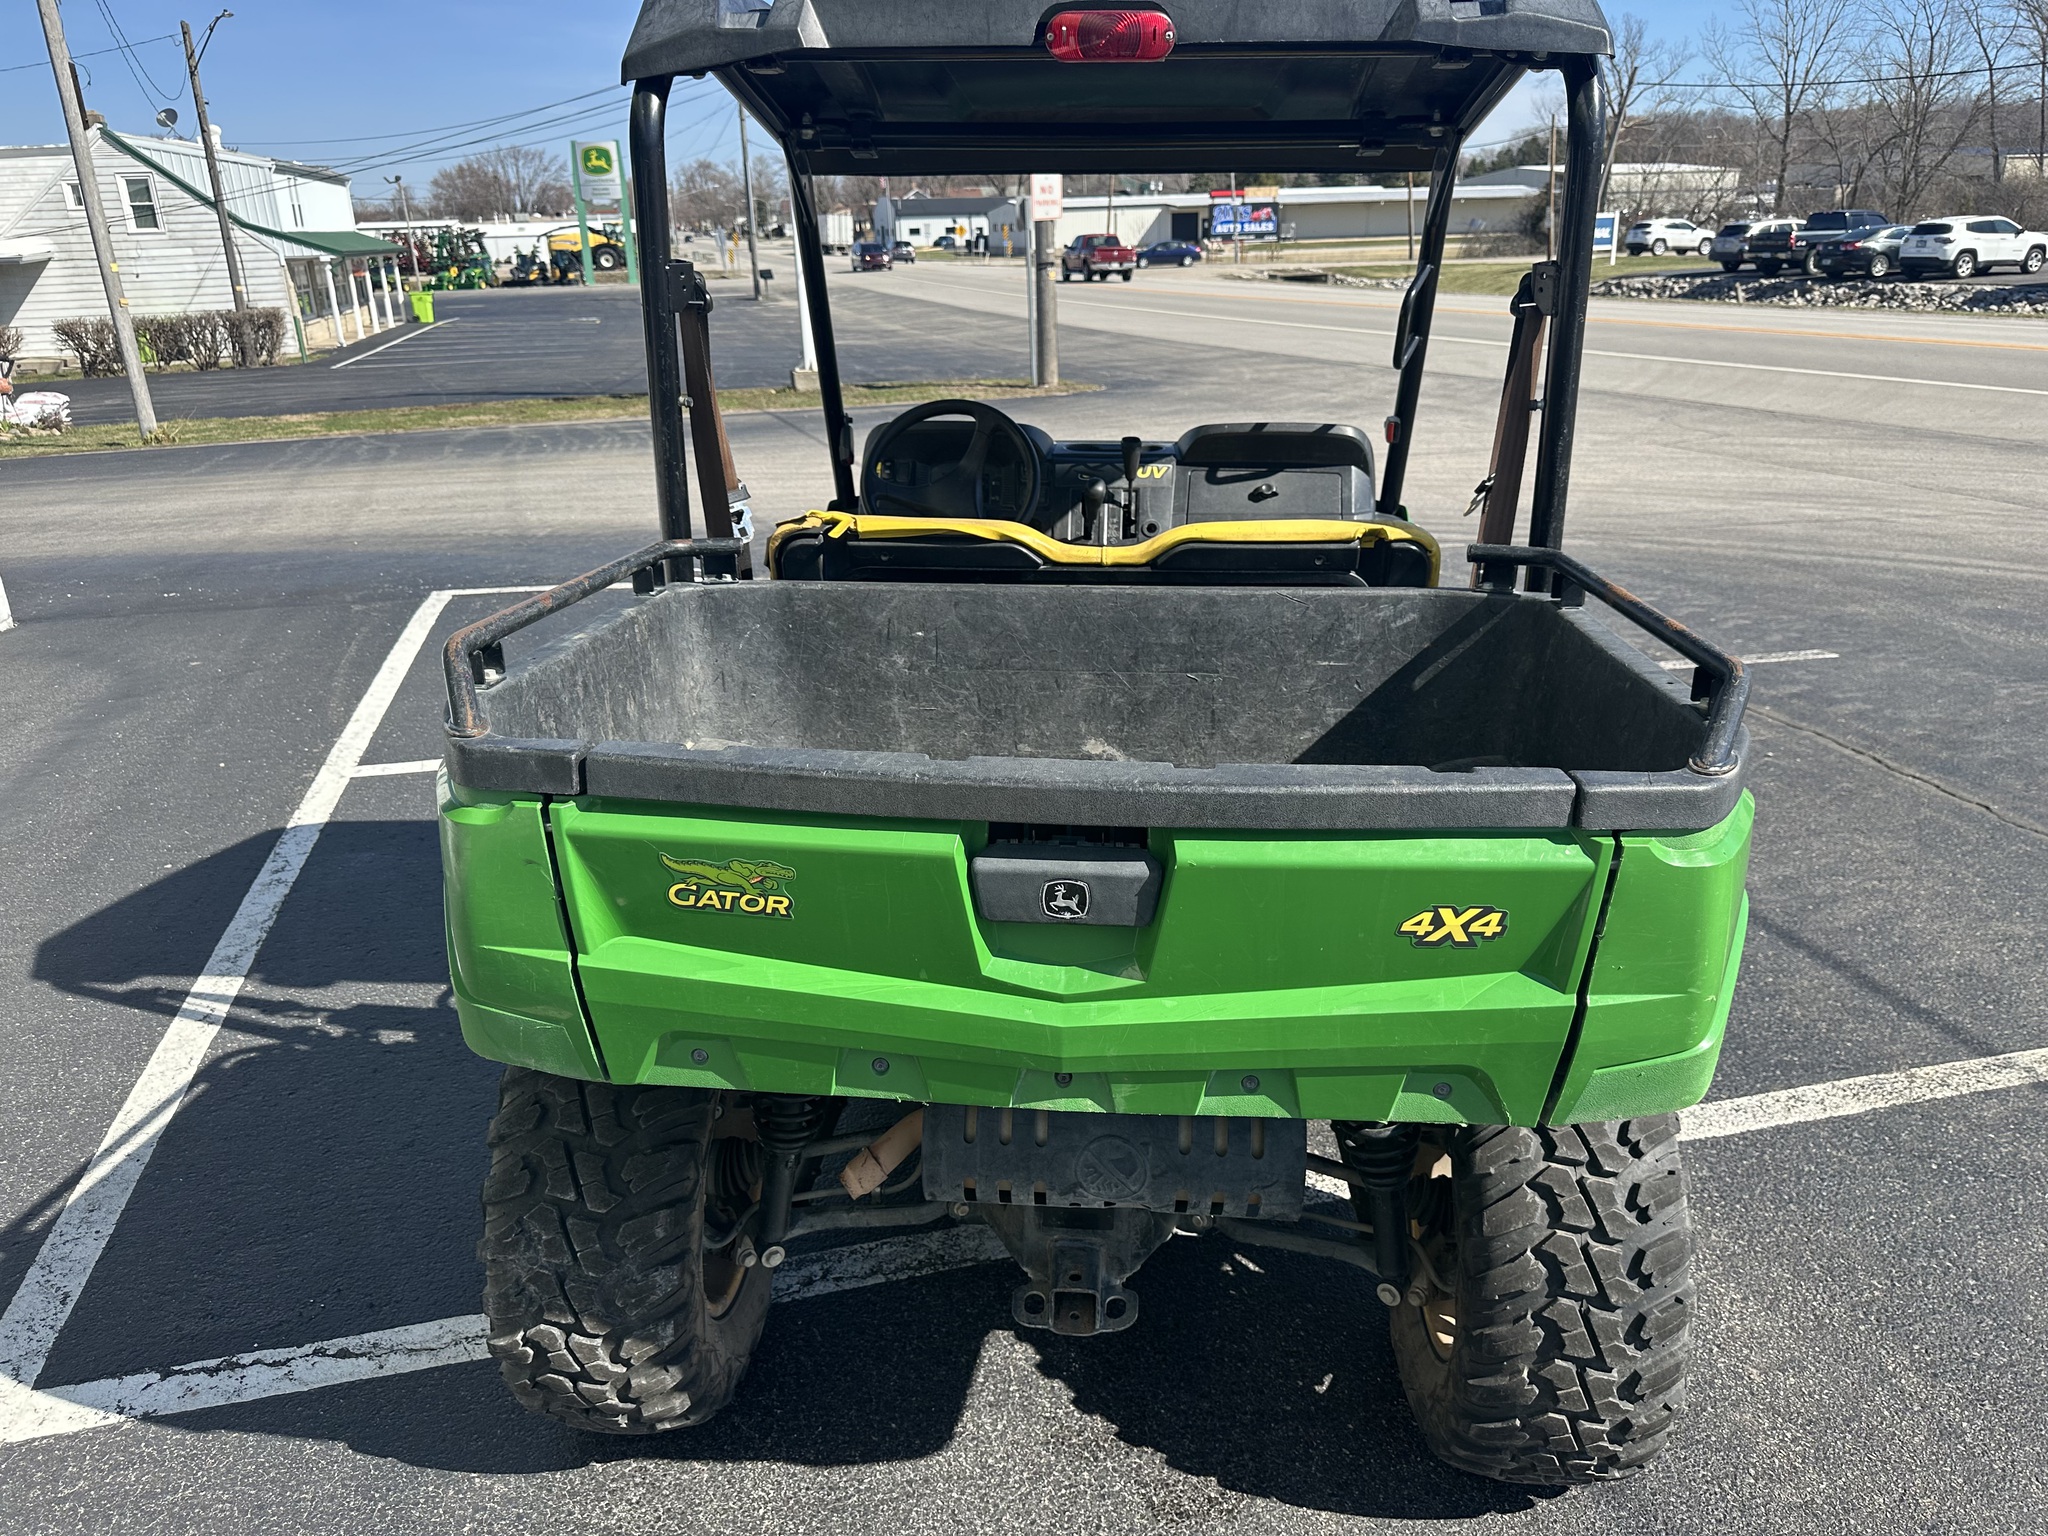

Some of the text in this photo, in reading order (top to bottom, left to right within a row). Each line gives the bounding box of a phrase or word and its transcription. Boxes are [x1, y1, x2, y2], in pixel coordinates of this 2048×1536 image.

[1040, 185, 1054, 195] NO
[1215, 222, 1274, 233] AUTO SALES
[667, 882, 790, 916] GATOR
[1399, 907, 1503, 942] 4X4
